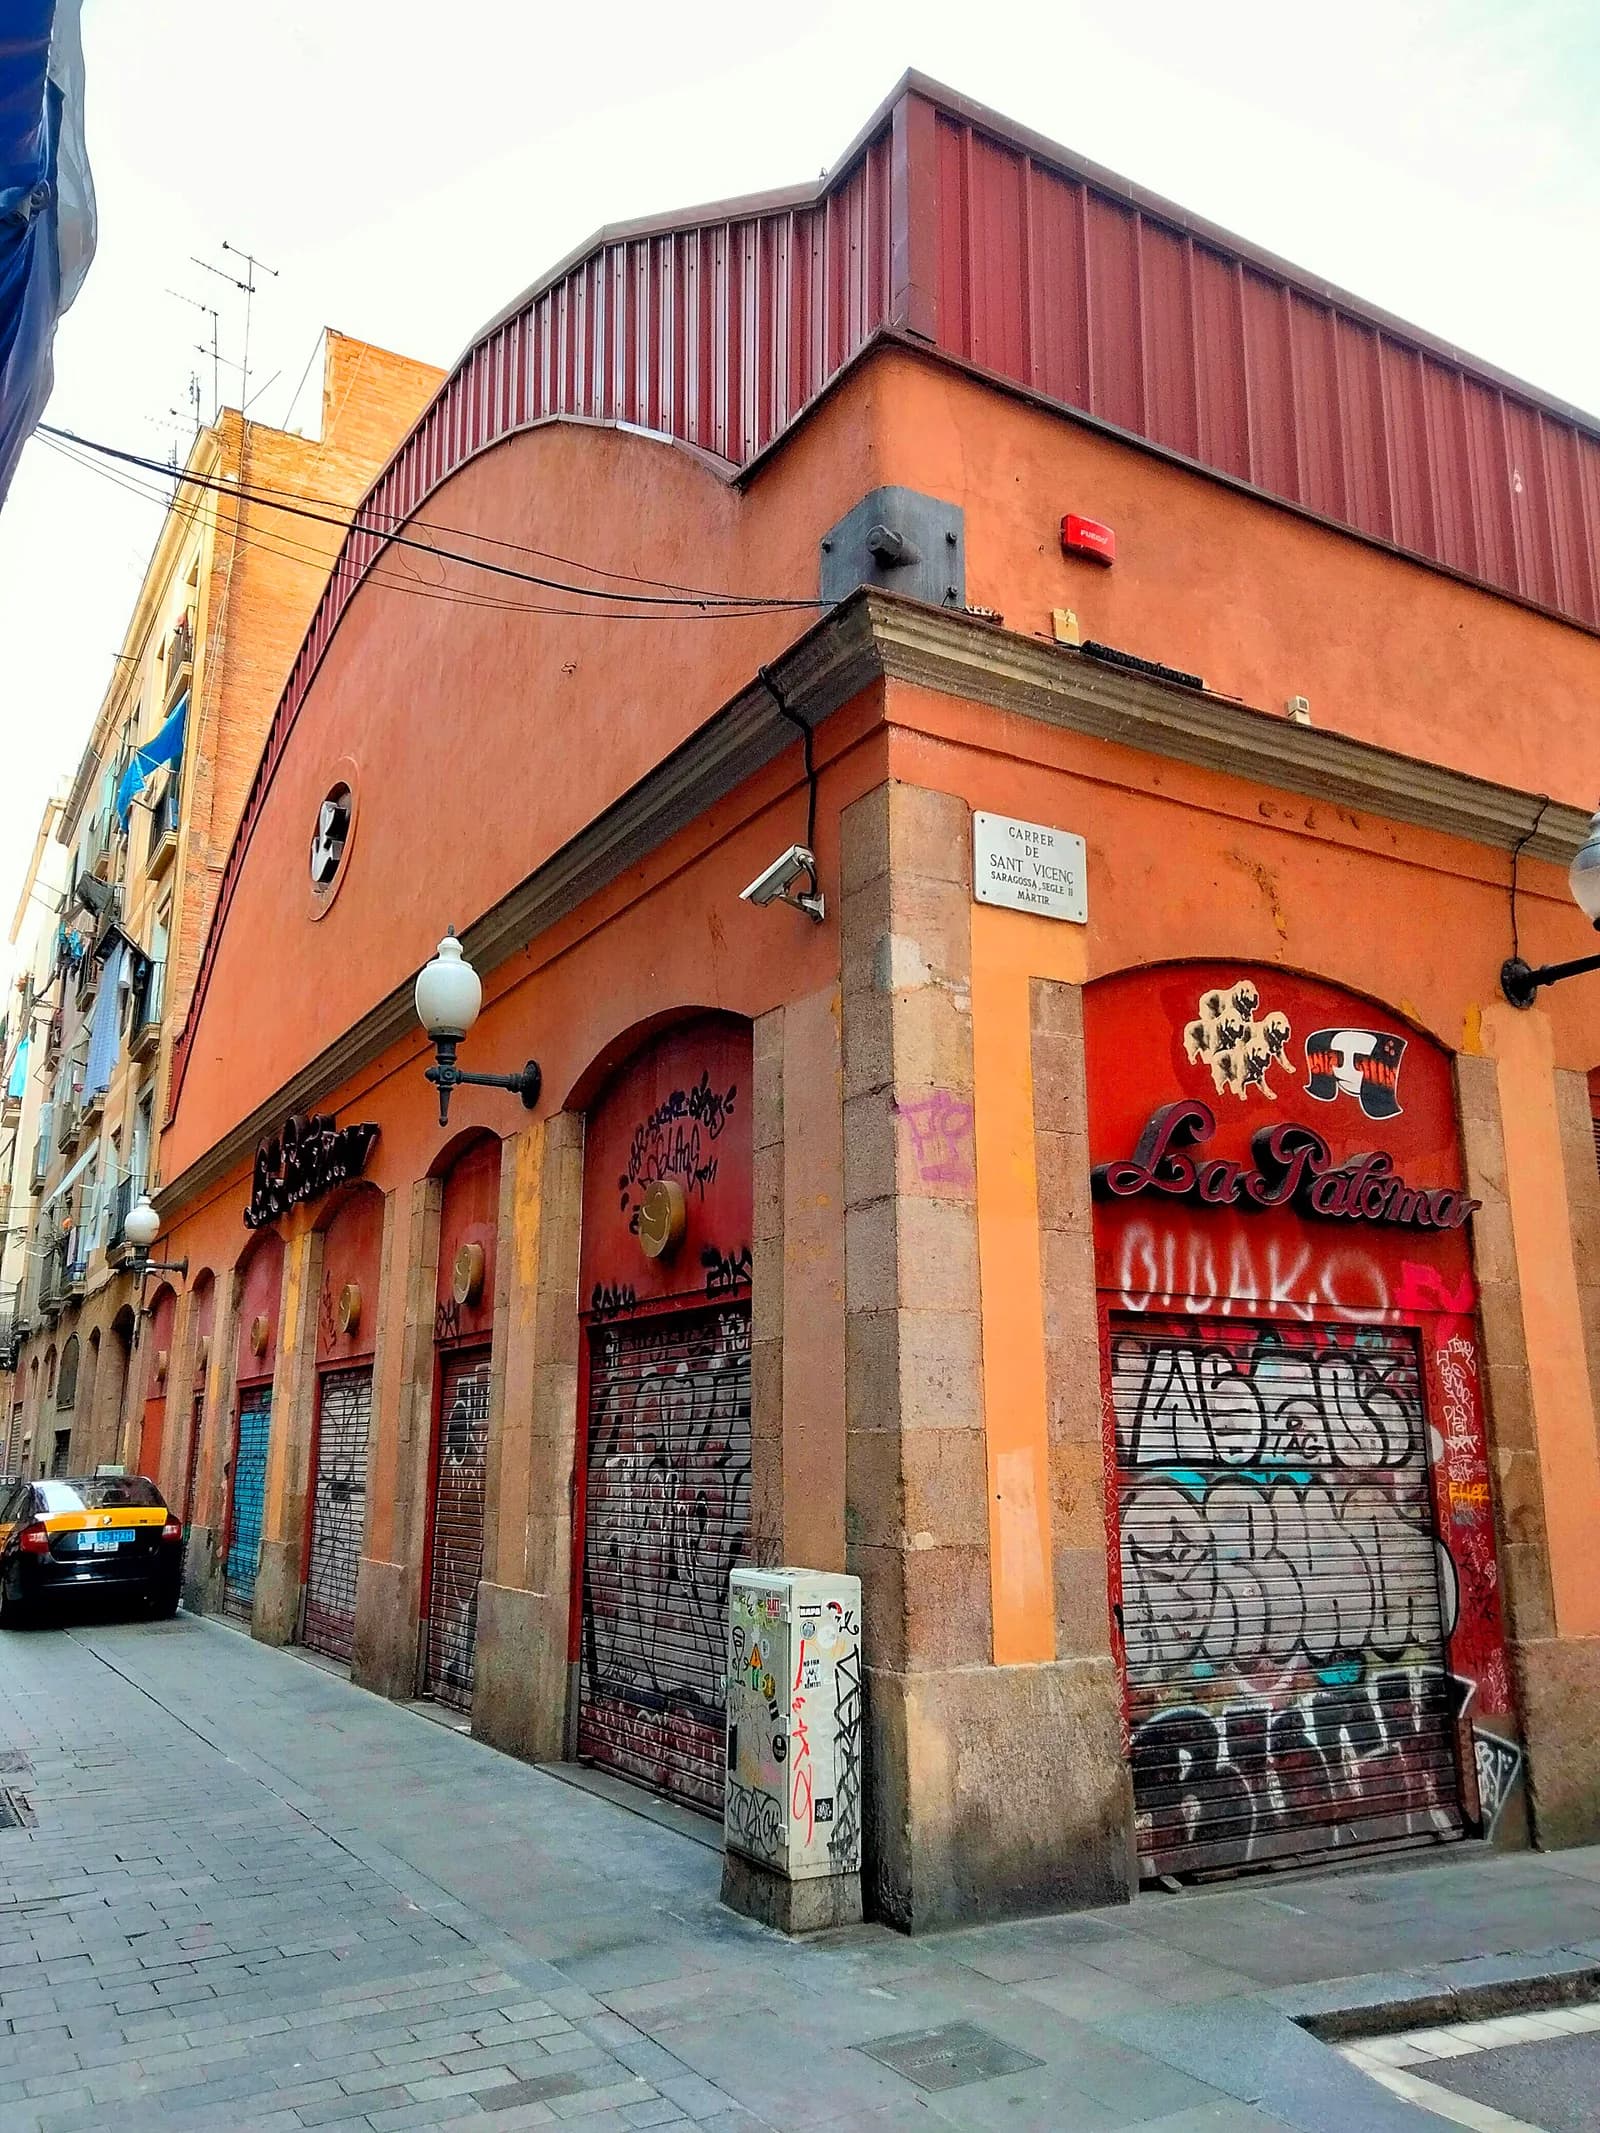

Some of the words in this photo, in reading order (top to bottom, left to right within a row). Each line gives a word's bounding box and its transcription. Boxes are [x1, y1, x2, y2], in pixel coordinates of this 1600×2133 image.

[1008, 826, 1054, 847] CARRER
[1025, 845, 1039, 858] DE
[990, 853, 1024, 873] SANT
[1033, 862, 1074, 885] VICENÇ
[1042, 881, 1065, 895] SEGLE
[1092, 1099, 1242, 1204] La
[1244, 1121, 1482, 1229] Paloma
